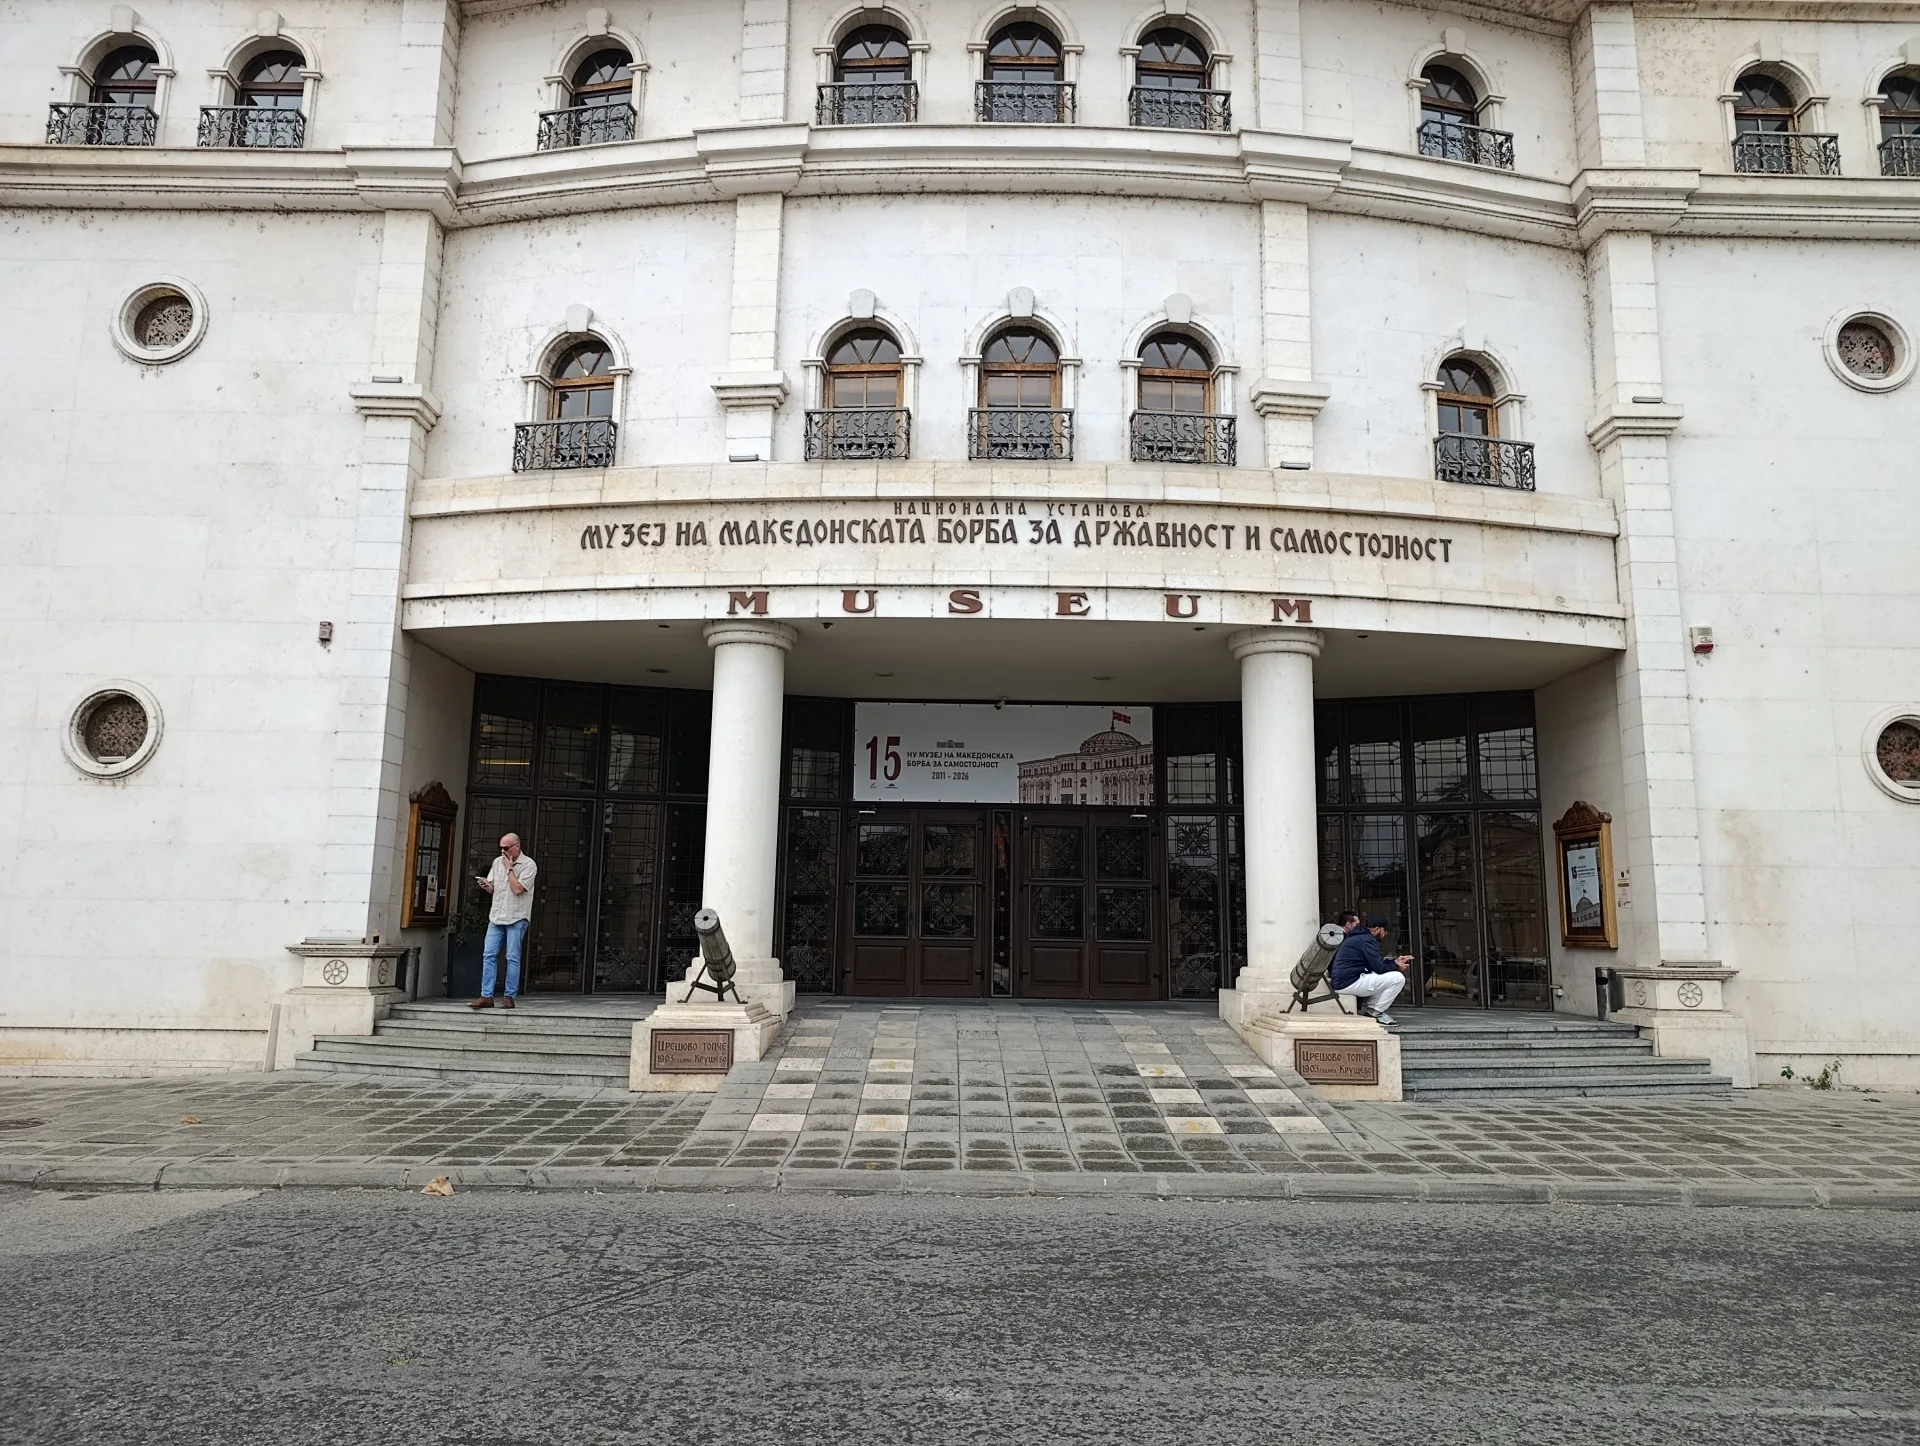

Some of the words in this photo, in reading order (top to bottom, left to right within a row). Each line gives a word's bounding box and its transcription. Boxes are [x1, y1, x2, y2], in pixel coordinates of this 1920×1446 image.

[893, 501, 1027, 516] НАЦИОНАЛНА
[1046, 502, 1145, 518] УСТАНОВА
[580, 521, 667, 549] МУЗЕЈ
[675, 520, 708, 547] НА
[718, 518, 926, 547] МАКЕДОНСКАТА
[937, 518, 1018, 545] БОРБА
[1028, 519, 1062, 545] ЗА
[1073, 519, 1235, 550] ДРЖАВНОСТ
[1245, 525, 1261, 551] И
[1269, 526, 1453, 563] САМОСТОЈНОСТ
[726, 589, 1313, 623] MUSEUM
[866, 735, 902, 780] 15
[906, 751, 918, 759] НУ
[919, 751, 943, 759] МУЗЕЈ
[944, 751, 954, 759] НА
[956, 752, 1015, 760] МАКЕДОНСКАТА
[906, 760, 931, 768] БОРБА
[932, 760, 942, 768] ЗА
[943, 760, 1000, 769] САМОСТОЈНОСТ
[931, 771, 946, 780] 2011
[952, 772, 969, 780] 2026
